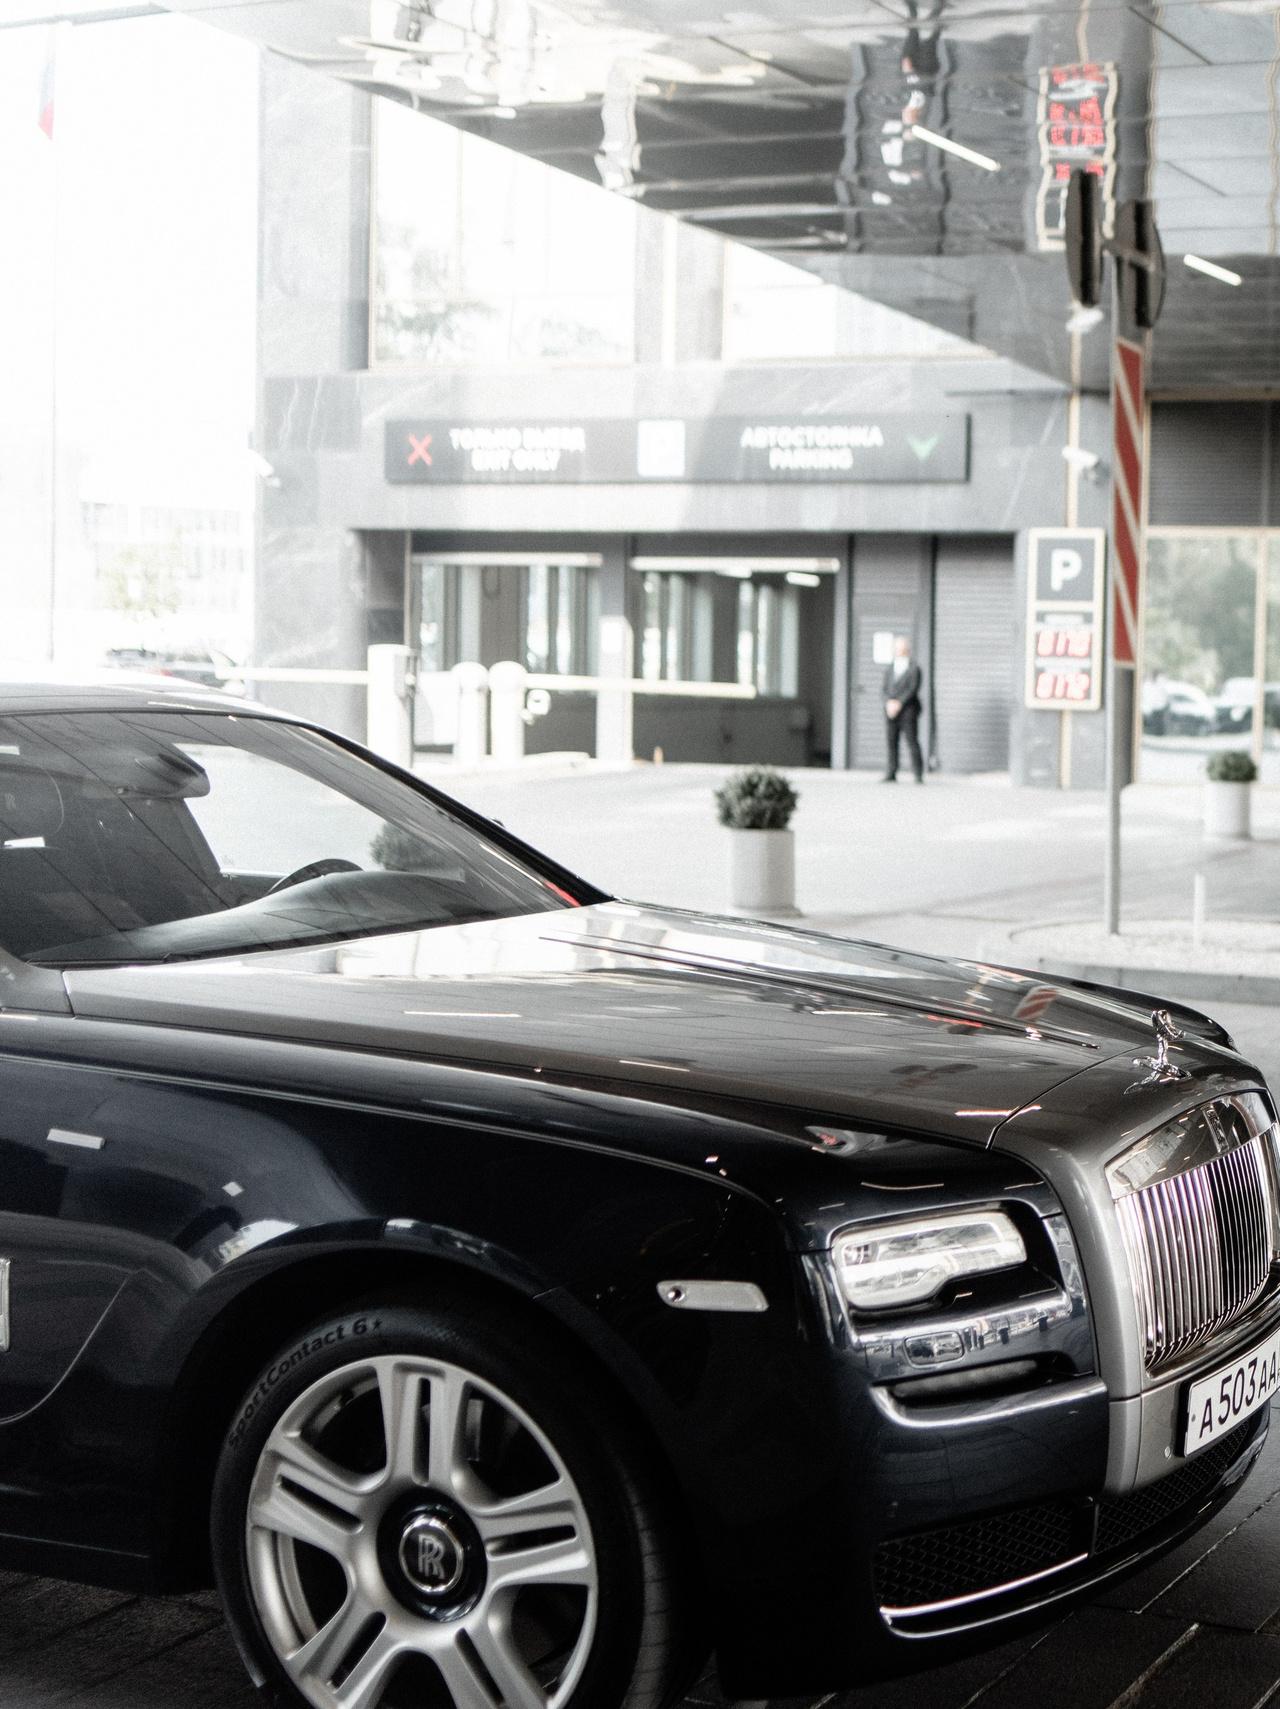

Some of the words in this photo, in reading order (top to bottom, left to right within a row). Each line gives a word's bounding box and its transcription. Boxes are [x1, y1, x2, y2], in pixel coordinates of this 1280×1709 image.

[741, 426, 883, 448] АВТОСТОЯНКА
[512, 450, 560, 471] ONLY
[769, 448, 853, 470] PARKING
[1050, 549, 1082, 591] P
[353, 1318, 368, 1335] 6
